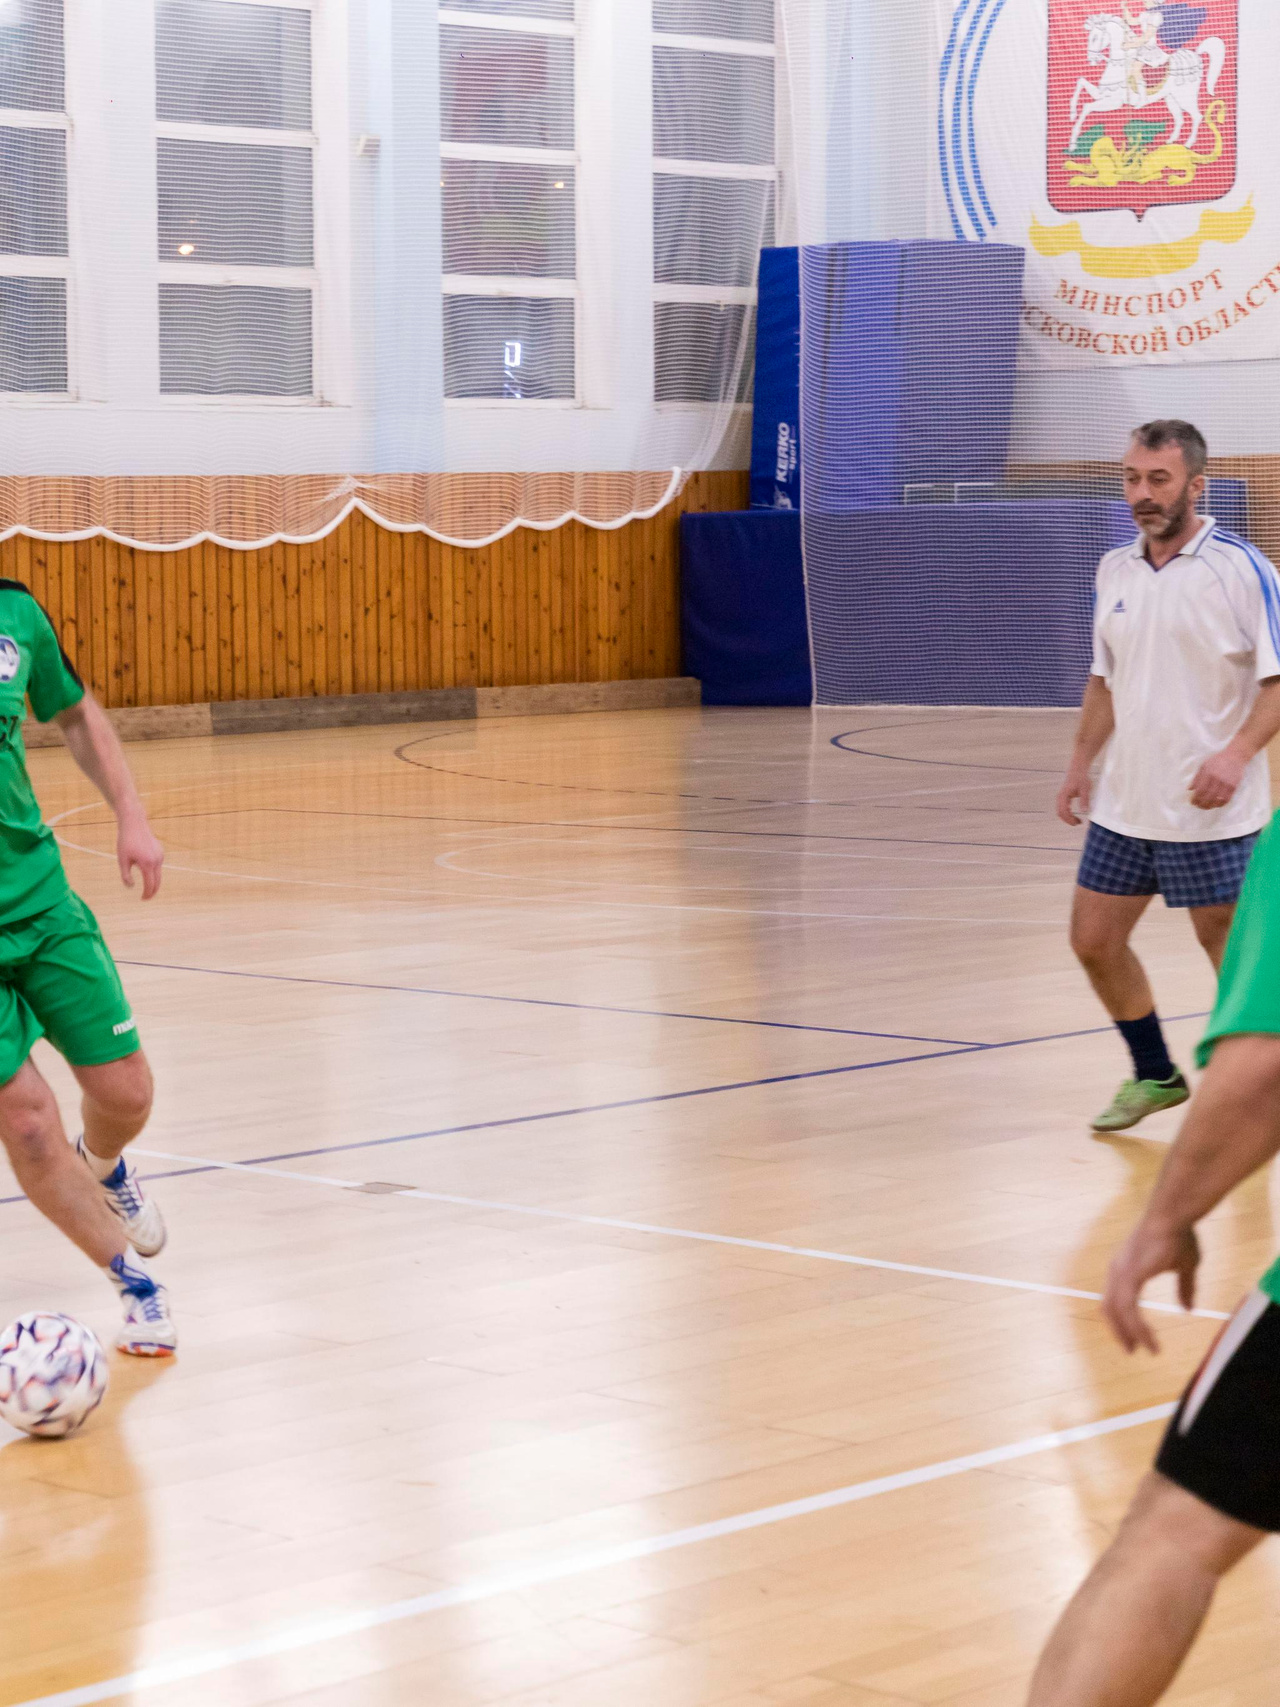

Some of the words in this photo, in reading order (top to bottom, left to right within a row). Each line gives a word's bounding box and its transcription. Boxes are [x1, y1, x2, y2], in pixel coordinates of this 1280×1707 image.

[1053, 268, 1224, 317] МИНСПОРТ
[1021, 300, 1169, 355] СКОВСКОЙ
[789, 439, 797, 470] sport
